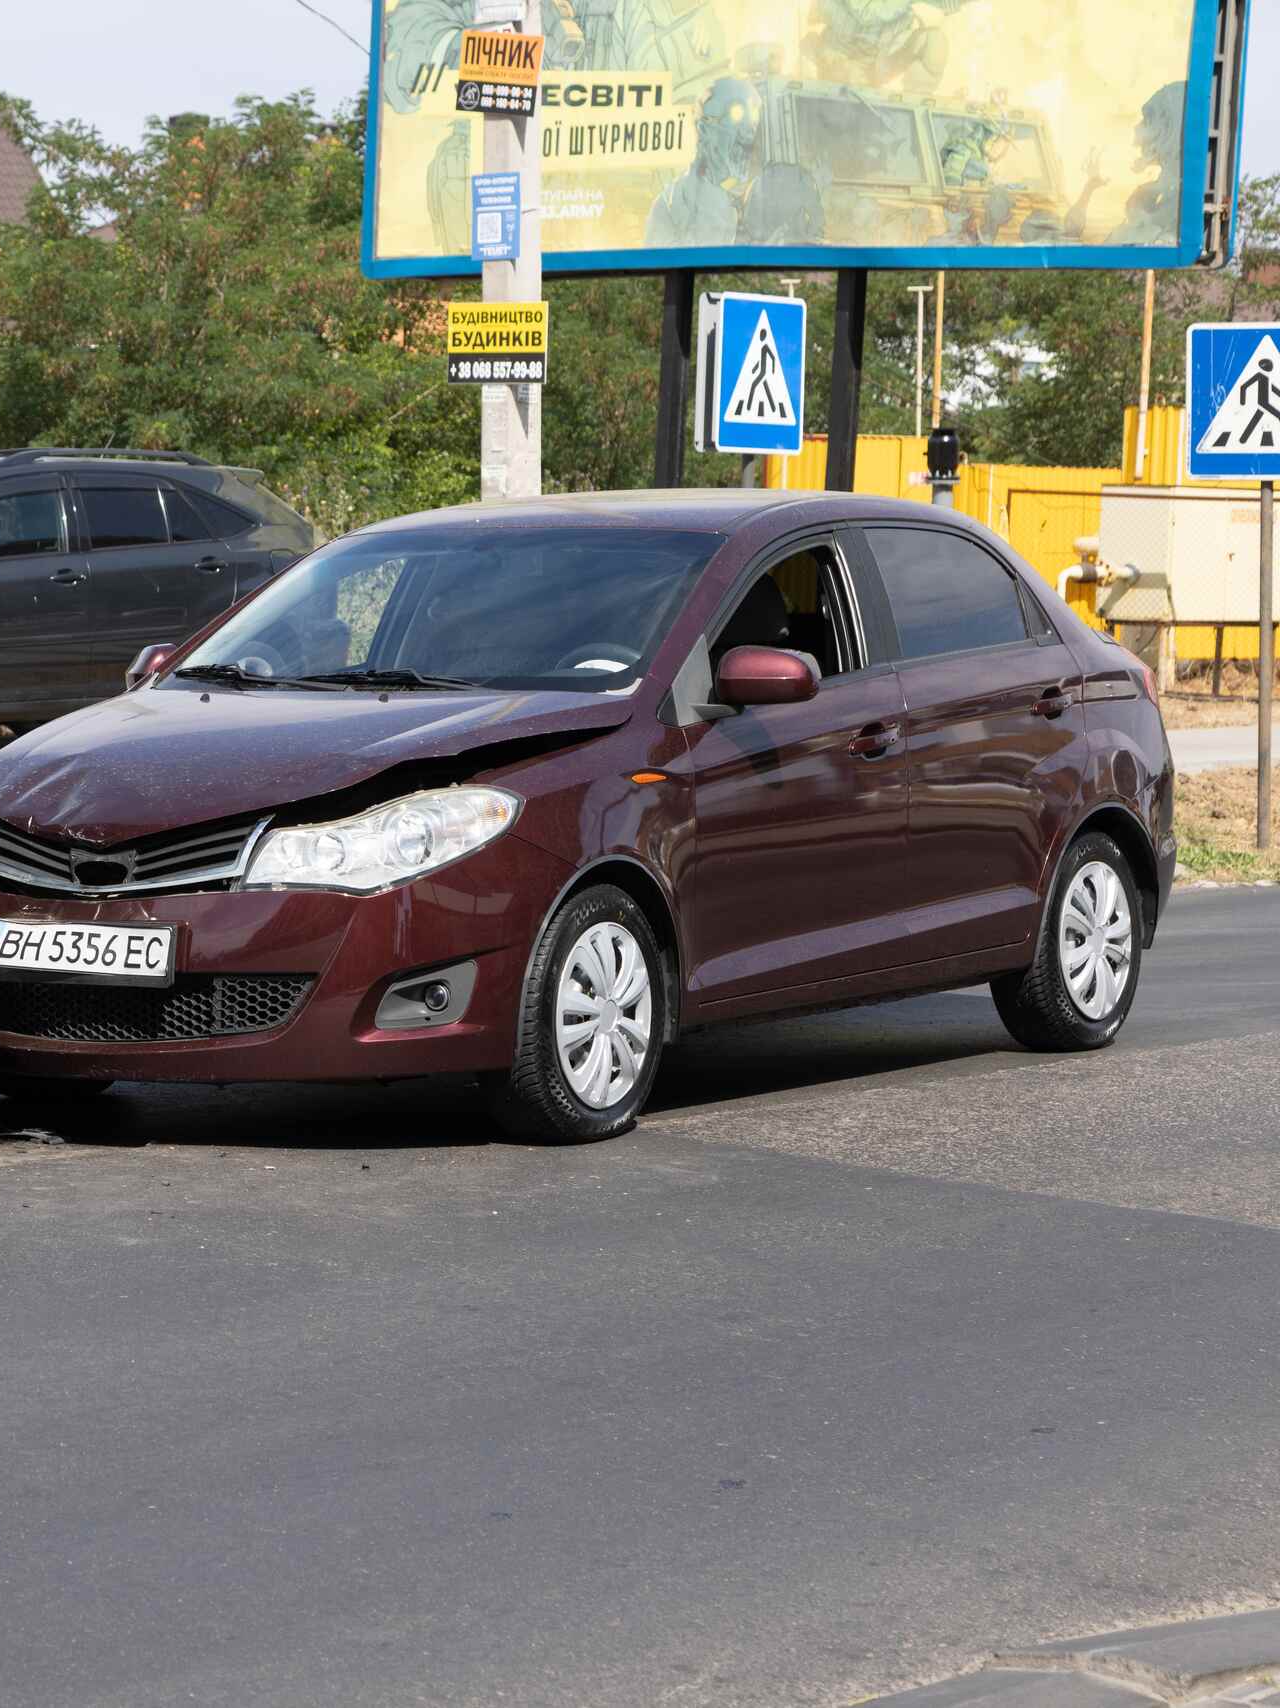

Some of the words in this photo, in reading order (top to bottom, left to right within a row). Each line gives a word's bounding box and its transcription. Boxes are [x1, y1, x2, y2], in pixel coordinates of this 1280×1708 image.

[465, 36, 538, 70] ПІЧНИК
[542, 84, 663, 107] ЕСВІТІ
[542, 120, 562, 157] ОЇ
[569, 112, 685, 156] ШТУРМОВОЇ
[452, 311, 543, 326] БУДІВНИЦТВО
[452, 331, 543, 350] БУДИНКІВ
[0, 929, 47, 961] BH
[48, 931, 119, 966] 5356
[124, 935, 164, 969] EC
